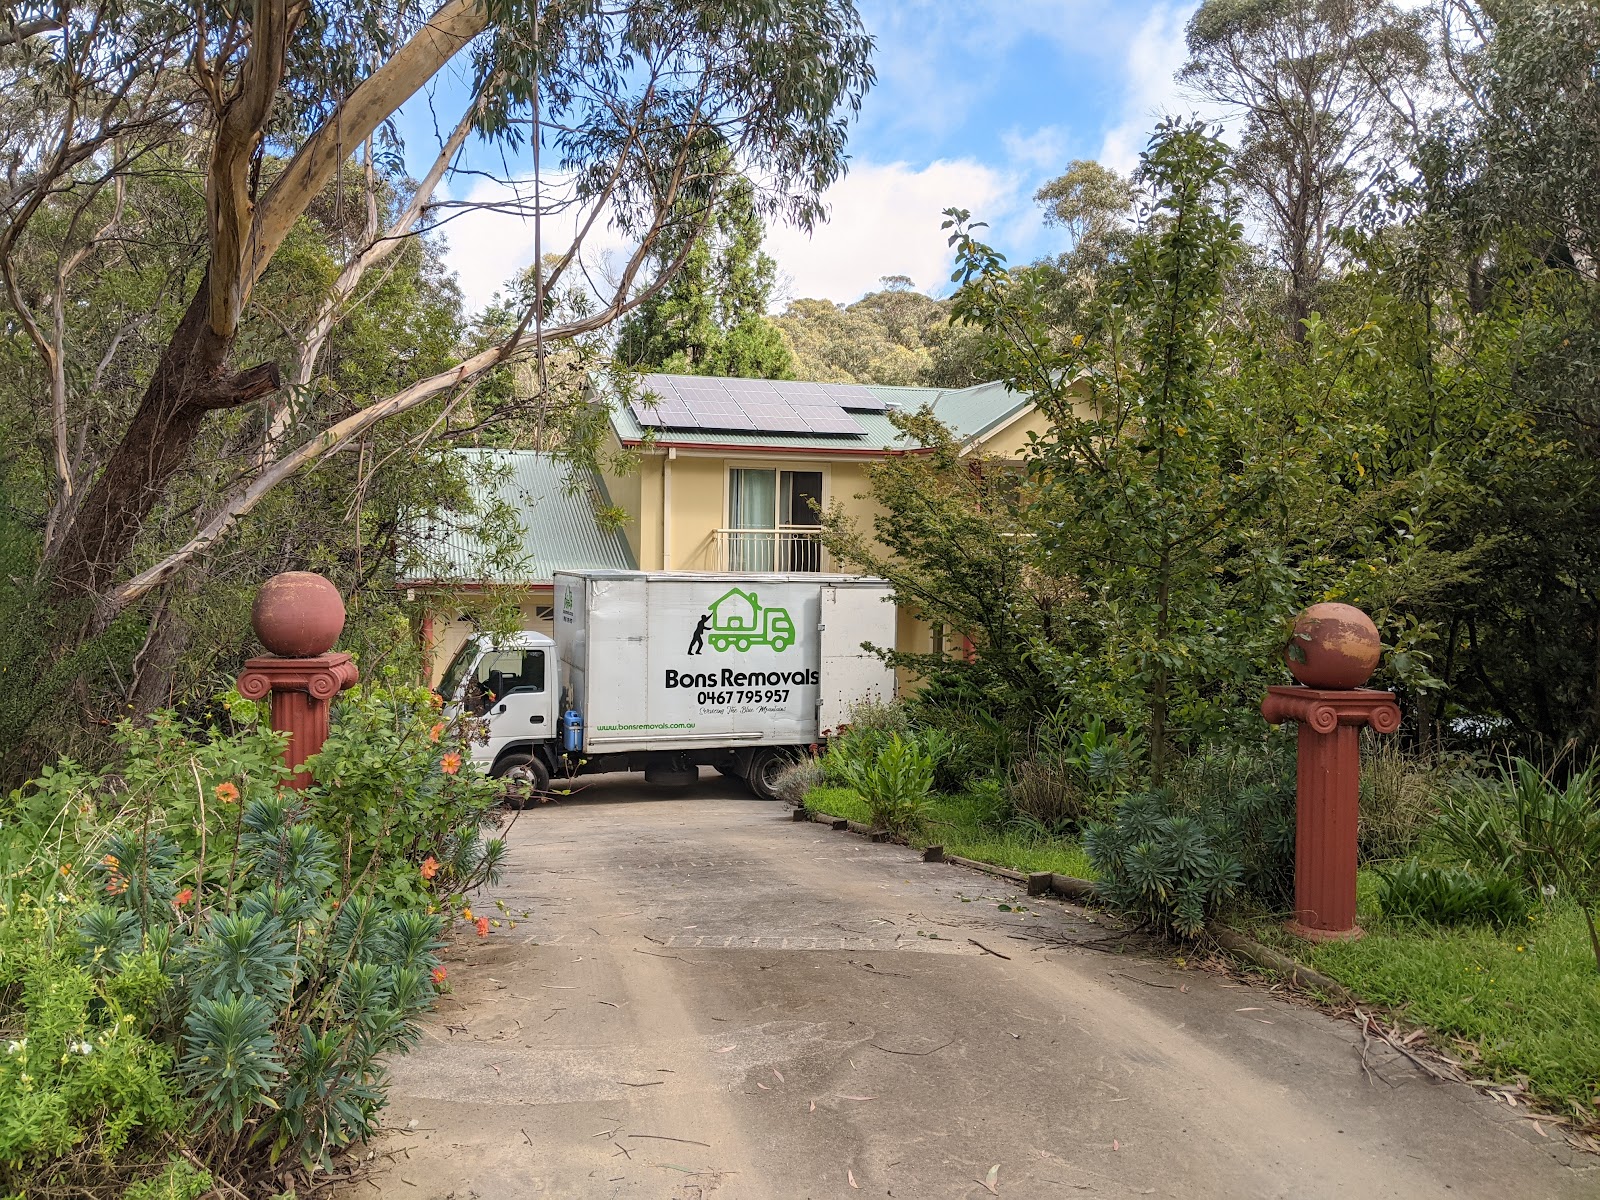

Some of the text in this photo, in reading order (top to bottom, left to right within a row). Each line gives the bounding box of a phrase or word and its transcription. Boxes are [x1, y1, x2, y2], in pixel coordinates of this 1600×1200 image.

[665, 668, 819, 688] Bons Removals
[697, 689, 790, 705] 0467 795 957
[596, 722, 696, 731] www.bonsremovals.com.au
